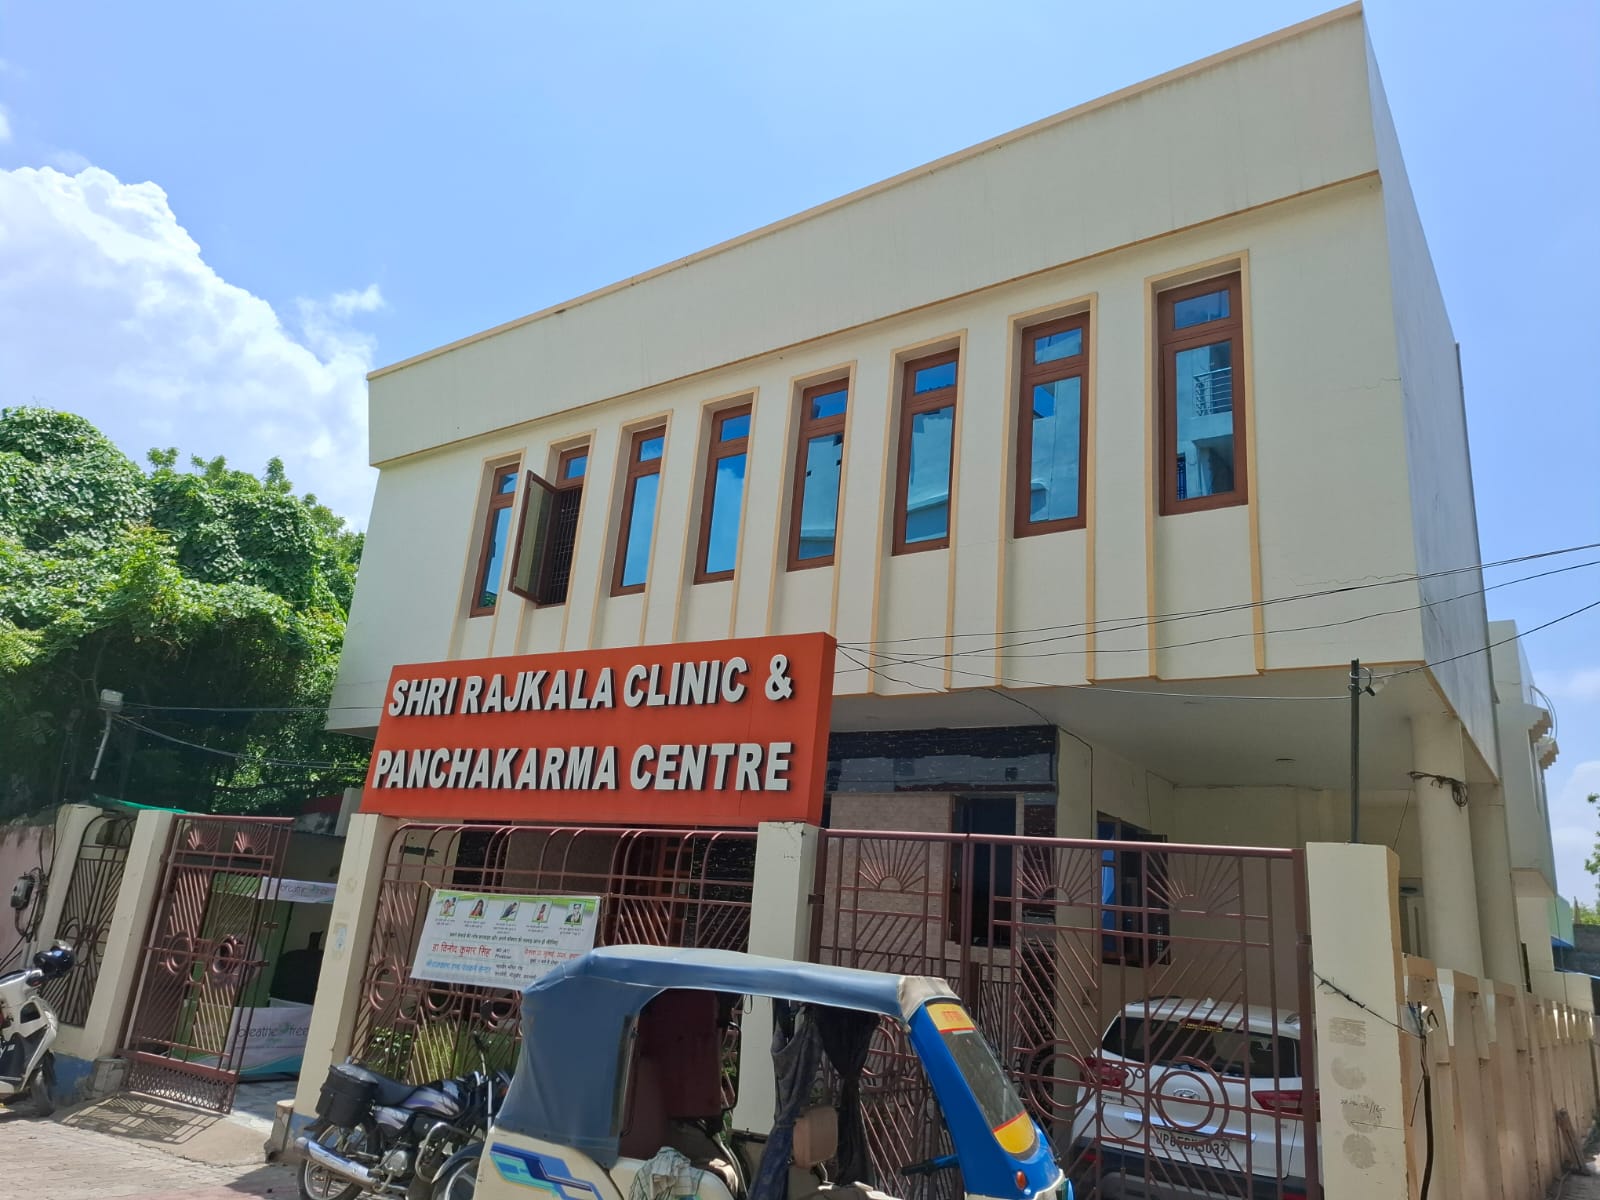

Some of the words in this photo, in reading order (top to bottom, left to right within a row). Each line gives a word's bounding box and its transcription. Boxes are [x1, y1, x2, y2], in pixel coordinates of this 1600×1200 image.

[388, 677, 457, 716] SHRI
[460, 667, 613, 714] RAJKALA
[623, 656, 748, 707] CLINIC
[764, 653, 793, 700] &
[371, 745, 617, 790] PANCHAKARMA
[629, 741, 793, 791] CENTRE
